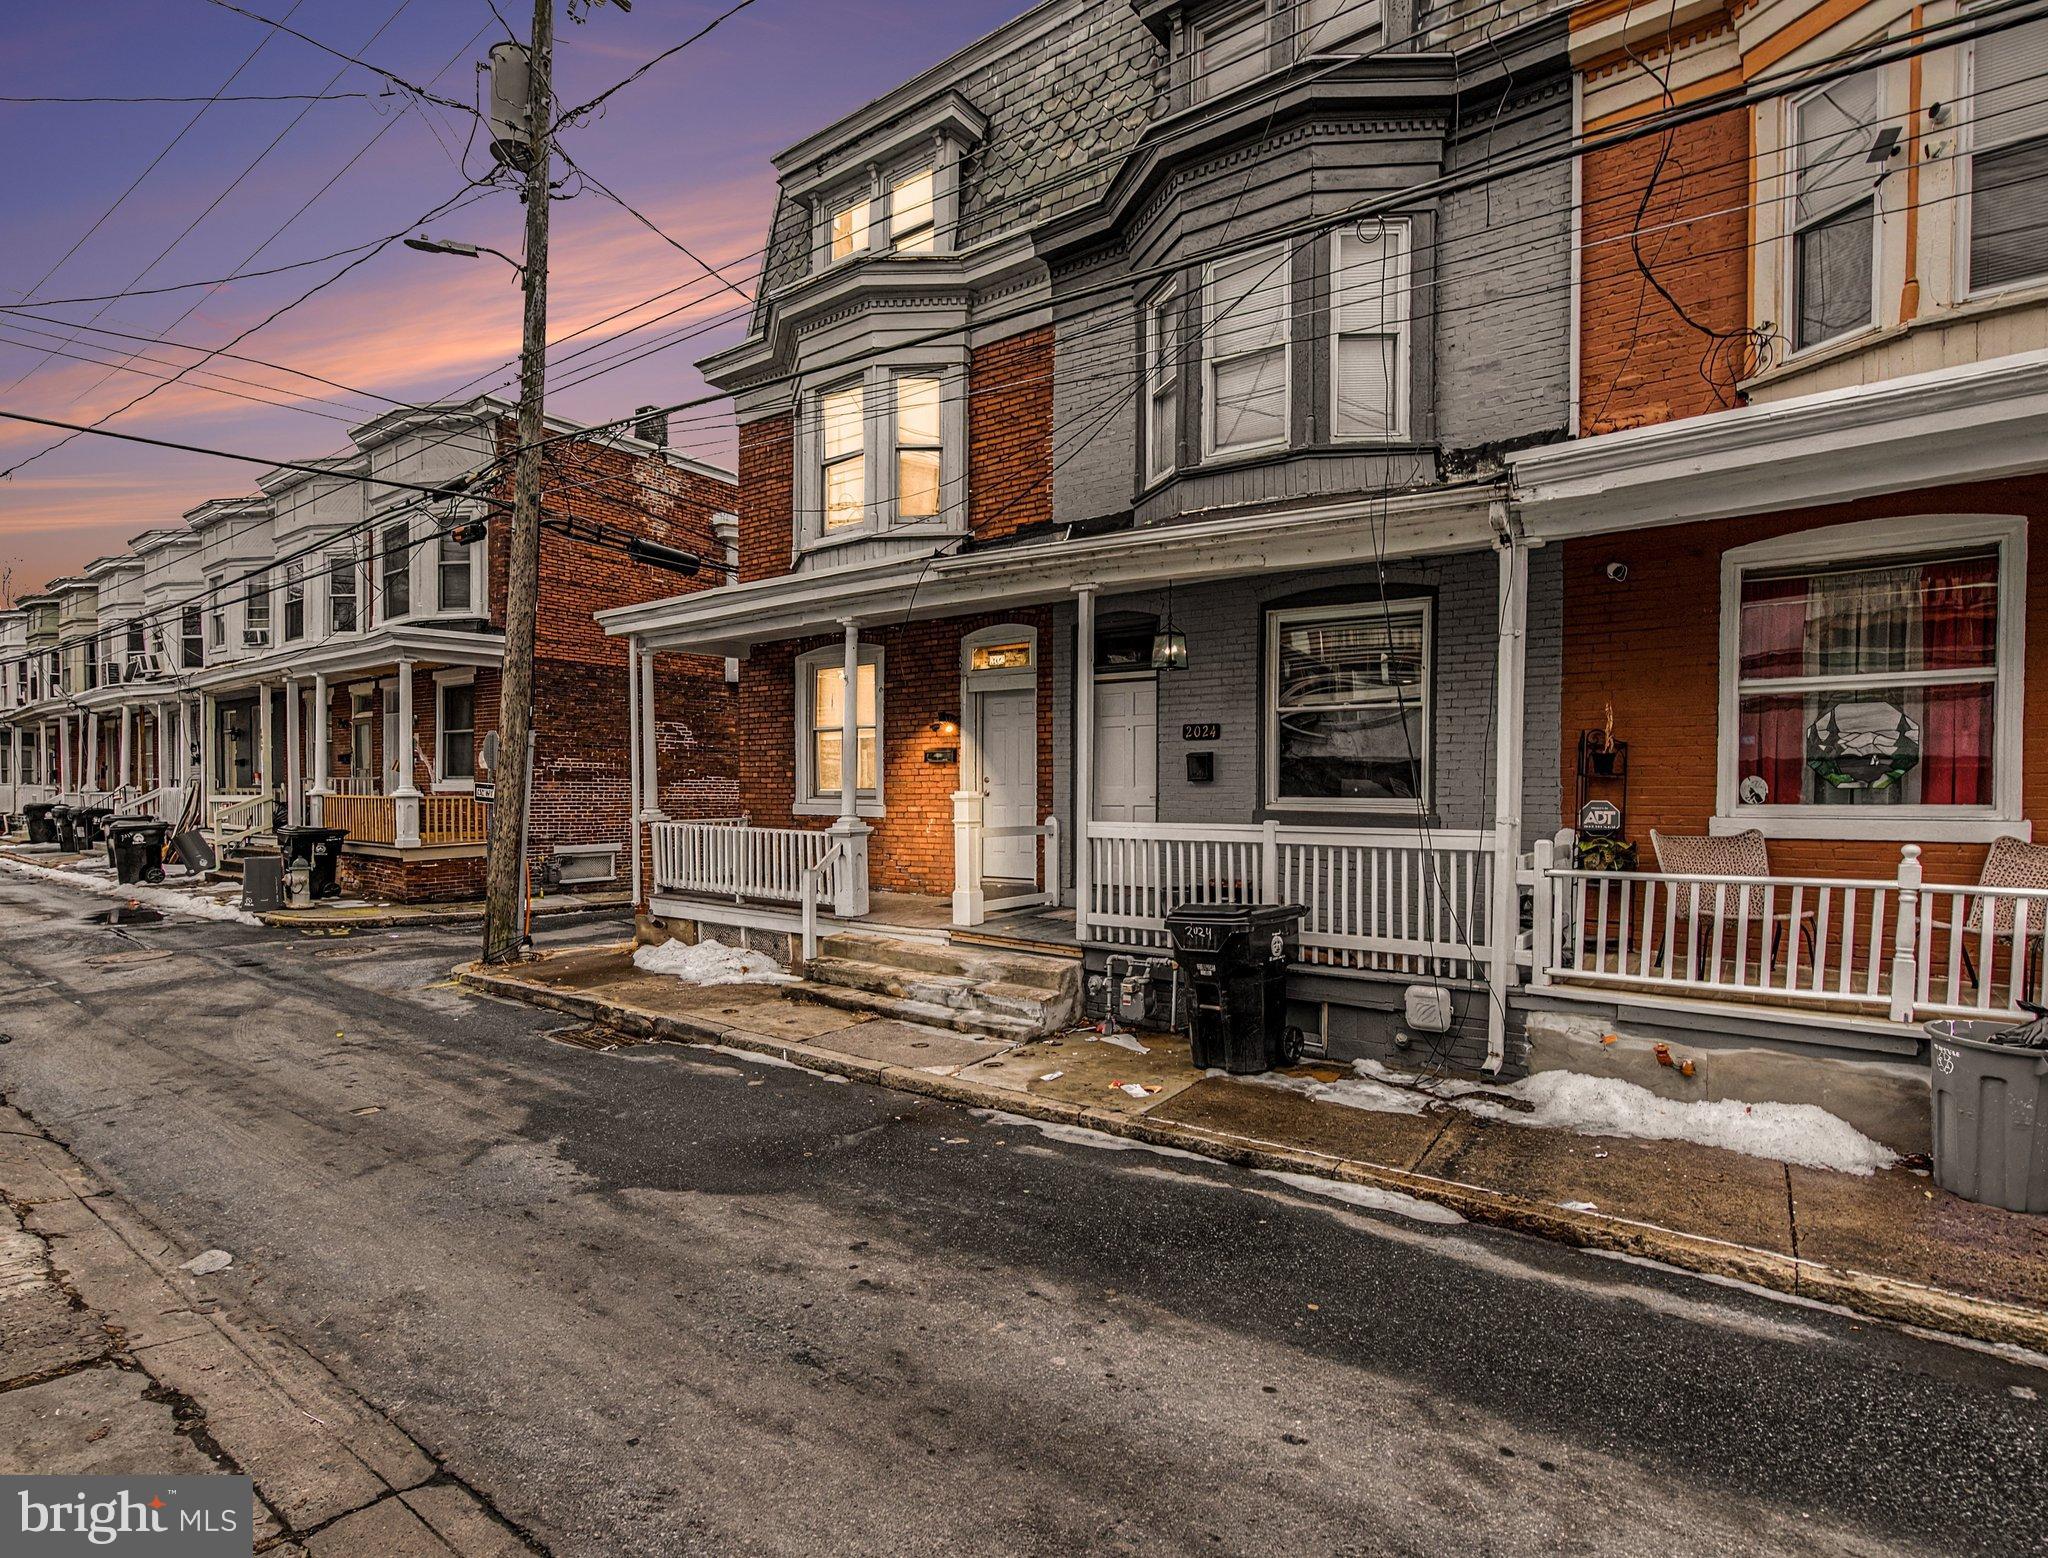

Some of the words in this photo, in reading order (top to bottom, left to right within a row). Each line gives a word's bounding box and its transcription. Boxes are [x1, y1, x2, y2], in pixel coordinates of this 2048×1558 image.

[1185, 725, 1216, 738] 2024
[1583, 810, 1616, 825] ADT
[1184, 926, 1212, 941] 2024
